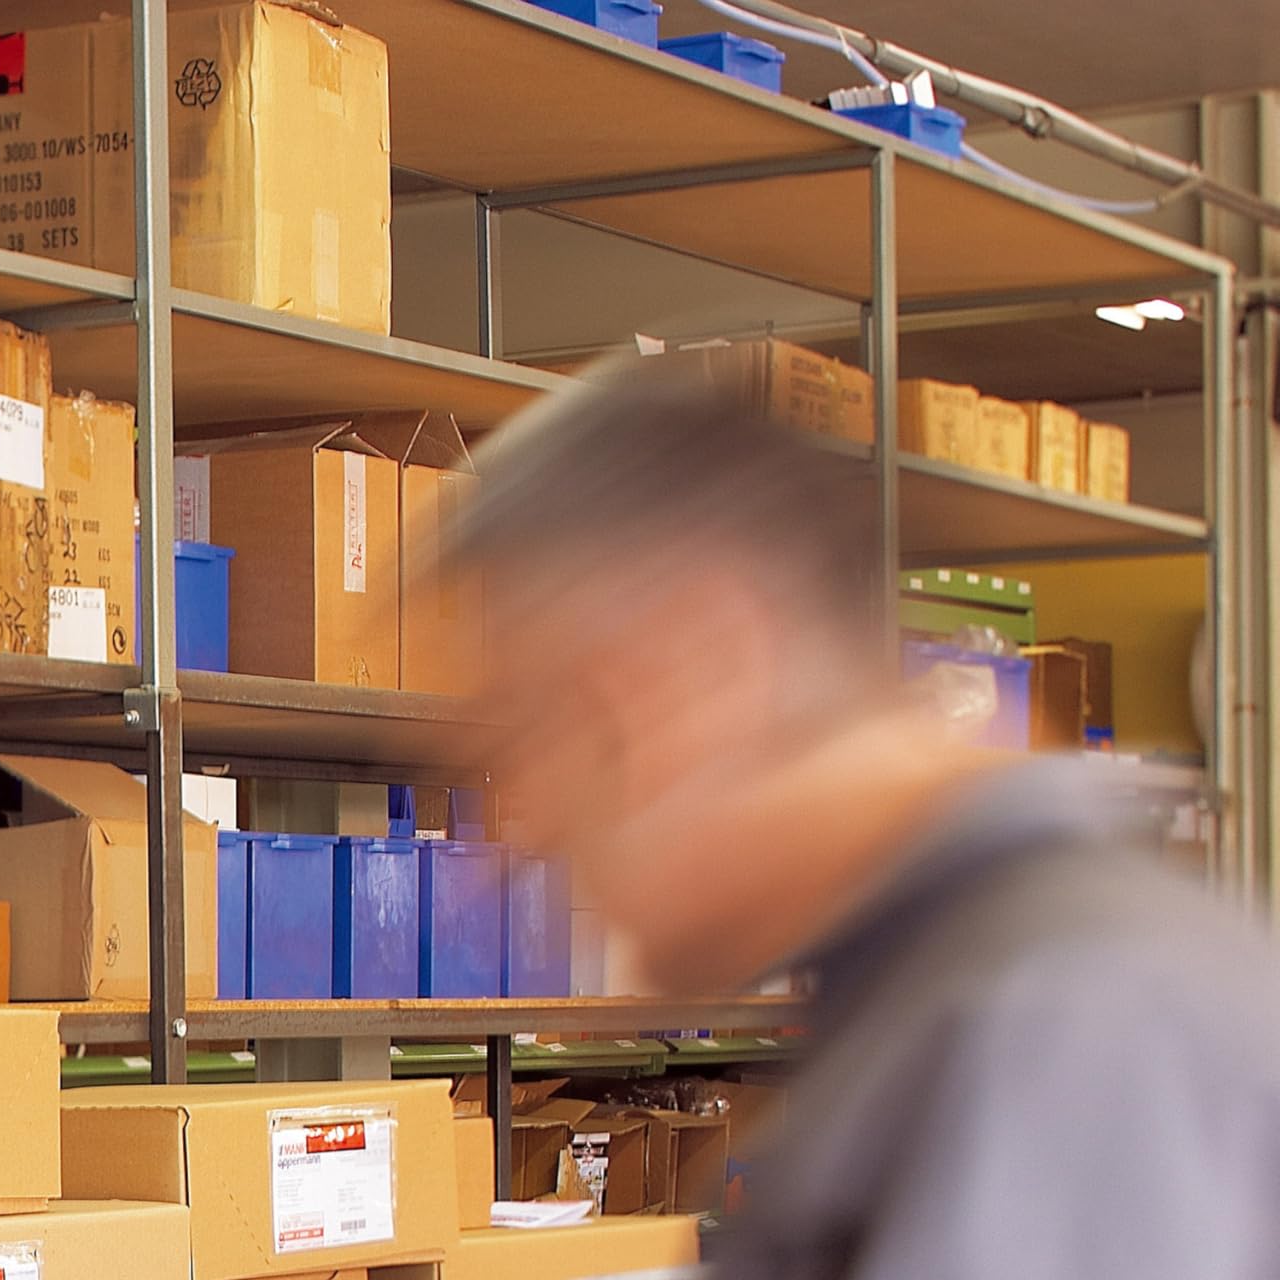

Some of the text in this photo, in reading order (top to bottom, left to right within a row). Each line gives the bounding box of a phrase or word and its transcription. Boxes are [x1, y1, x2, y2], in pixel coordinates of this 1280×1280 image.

[42, 227, 79, 248] SETS
[64, 569, 81, 585] 22
[278, 1155, 321, 1170] oppermann
